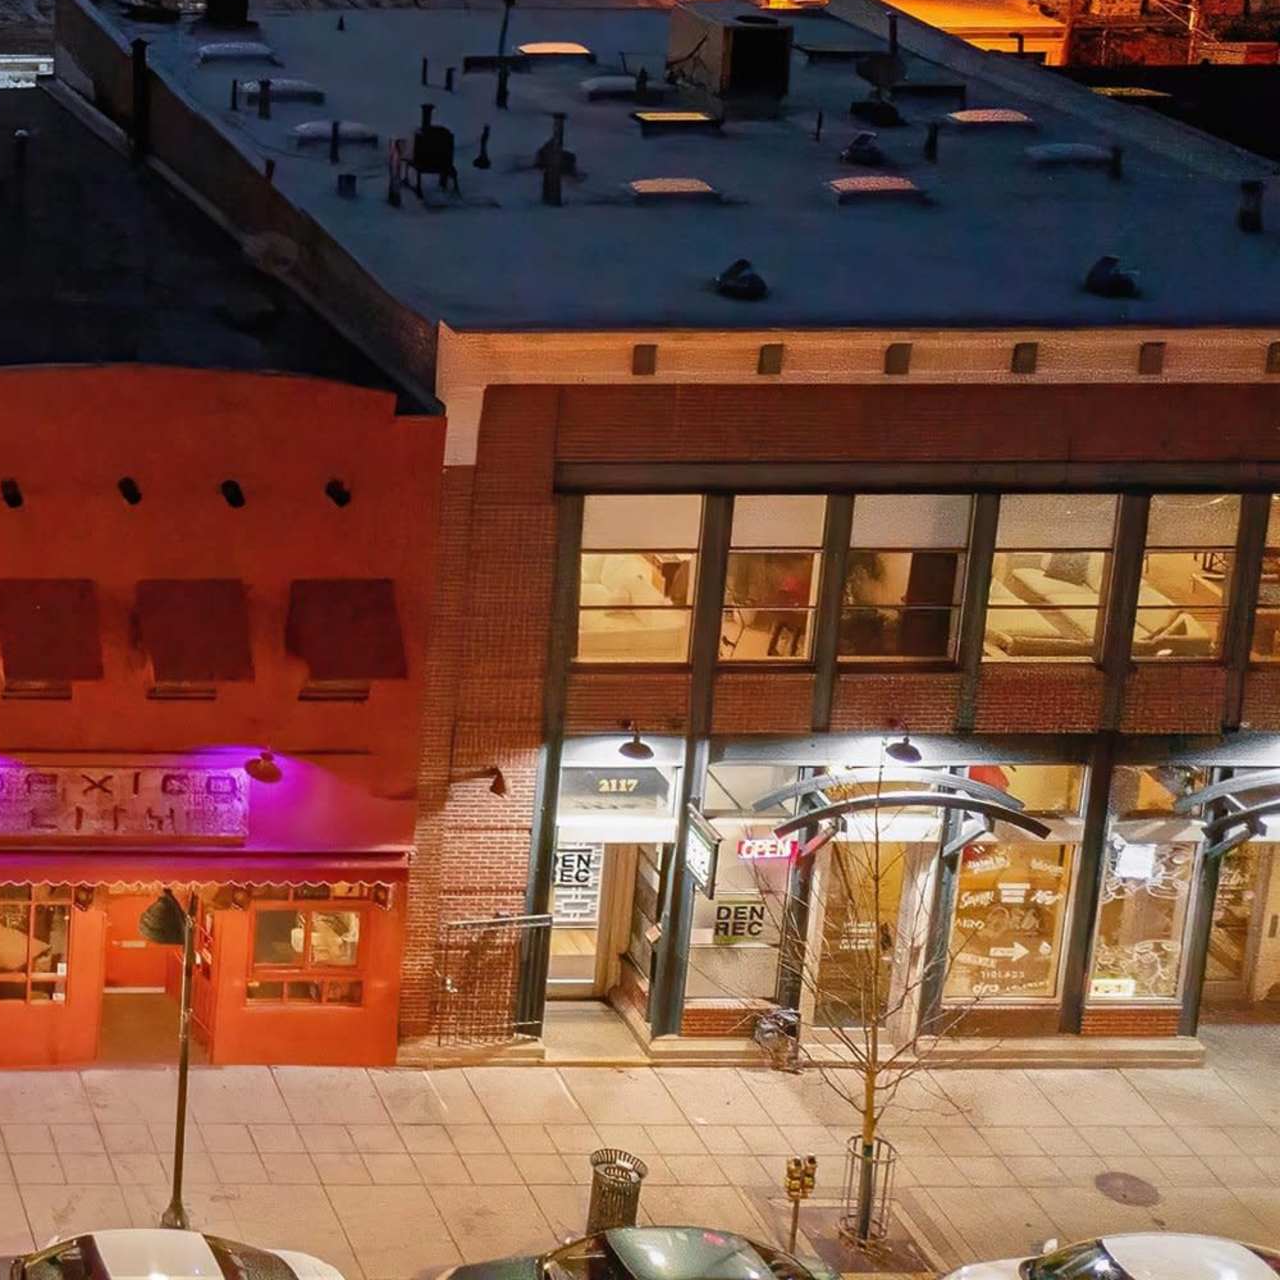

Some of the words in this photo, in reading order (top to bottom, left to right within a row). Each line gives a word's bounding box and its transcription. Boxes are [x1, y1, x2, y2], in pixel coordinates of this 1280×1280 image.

[598, 778, 639, 793] 2117
[742, 839, 791, 857] OPEN
[554, 853, 591, 869] EN
[553, 869, 590, 883] EC
[716, 905, 766, 921] DEN
[714, 921, 764, 937] REC
